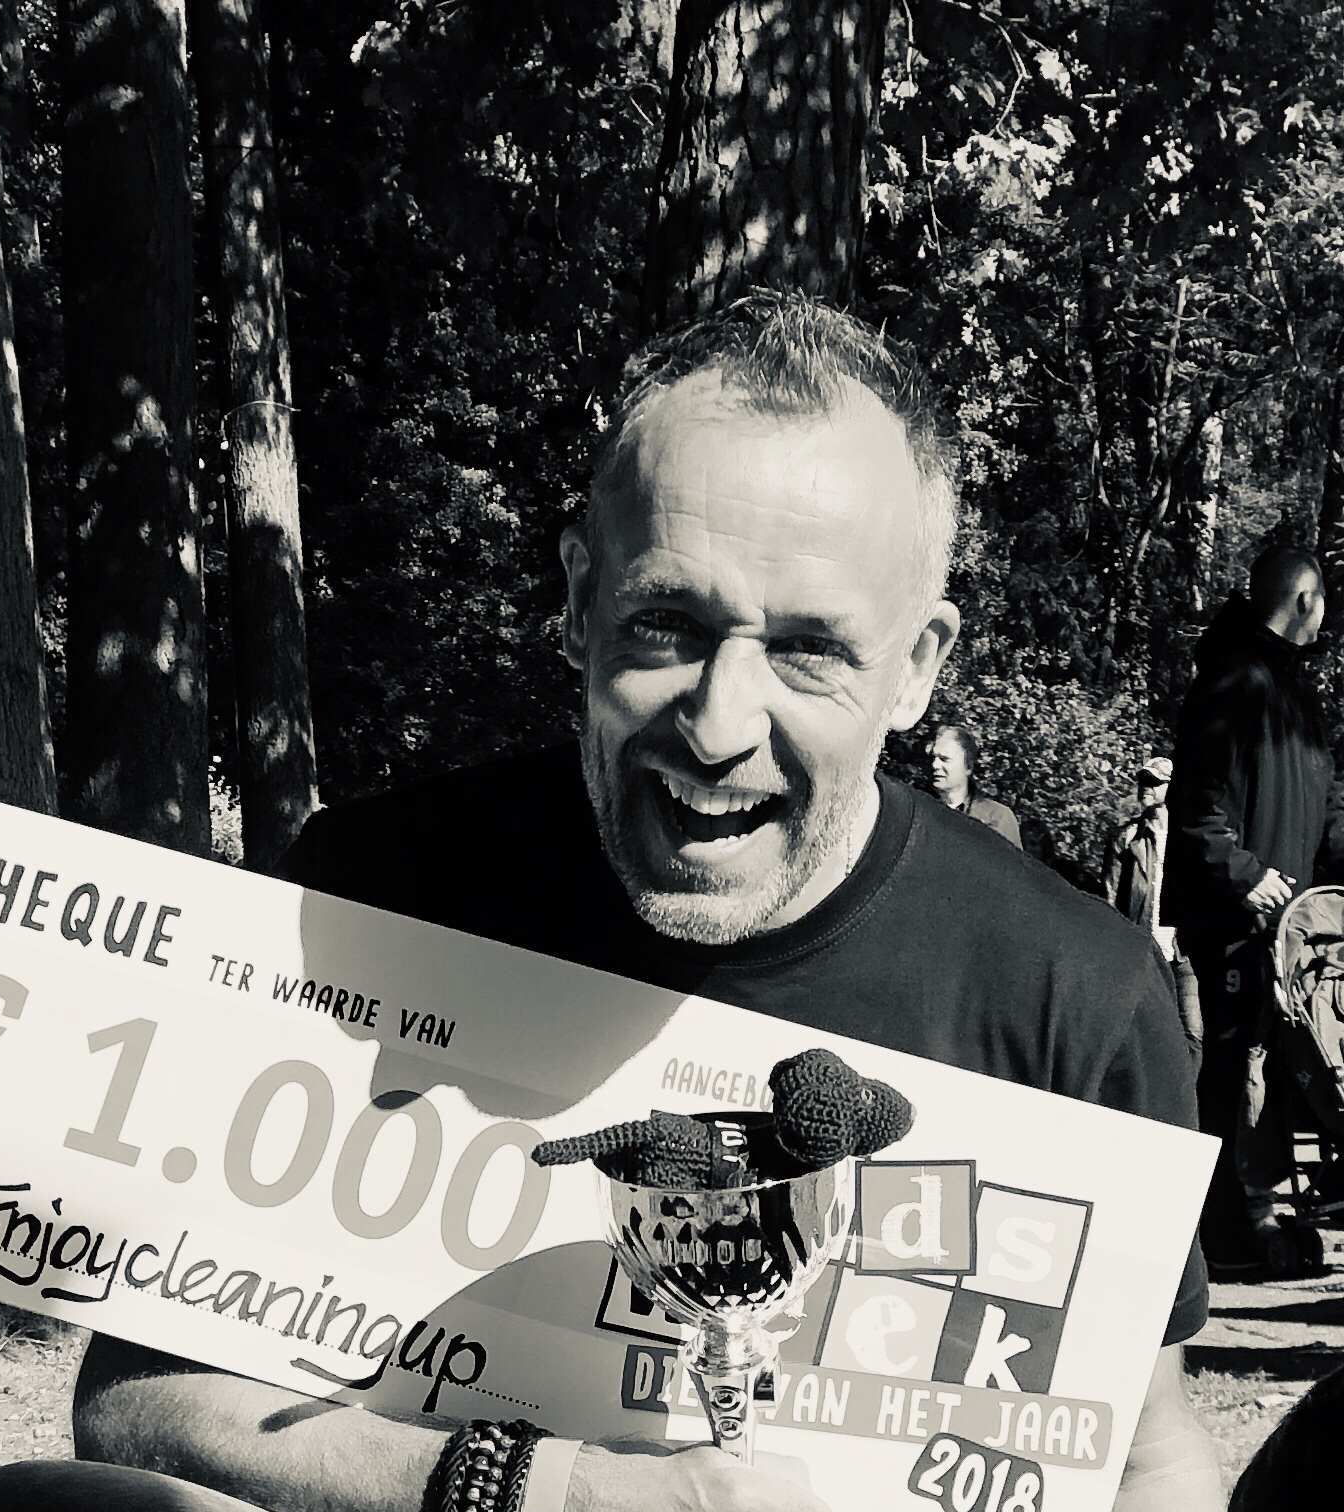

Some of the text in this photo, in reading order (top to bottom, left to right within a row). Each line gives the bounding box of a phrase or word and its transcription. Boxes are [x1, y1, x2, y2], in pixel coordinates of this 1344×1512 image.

[210, 954, 254, 992] TER
[273, 971, 381, 1029] WAARDE
[400, 1008, 457, 1049] VAN
[661, 1057, 773, 1112] AANGEBO
[62, 1017, 553, 1271] 1.000
[632, 1352, 702, 1407] DIE
[876, 1383, 963, 1439] HET
[983, 1397, 1098, 1461] JAAR
